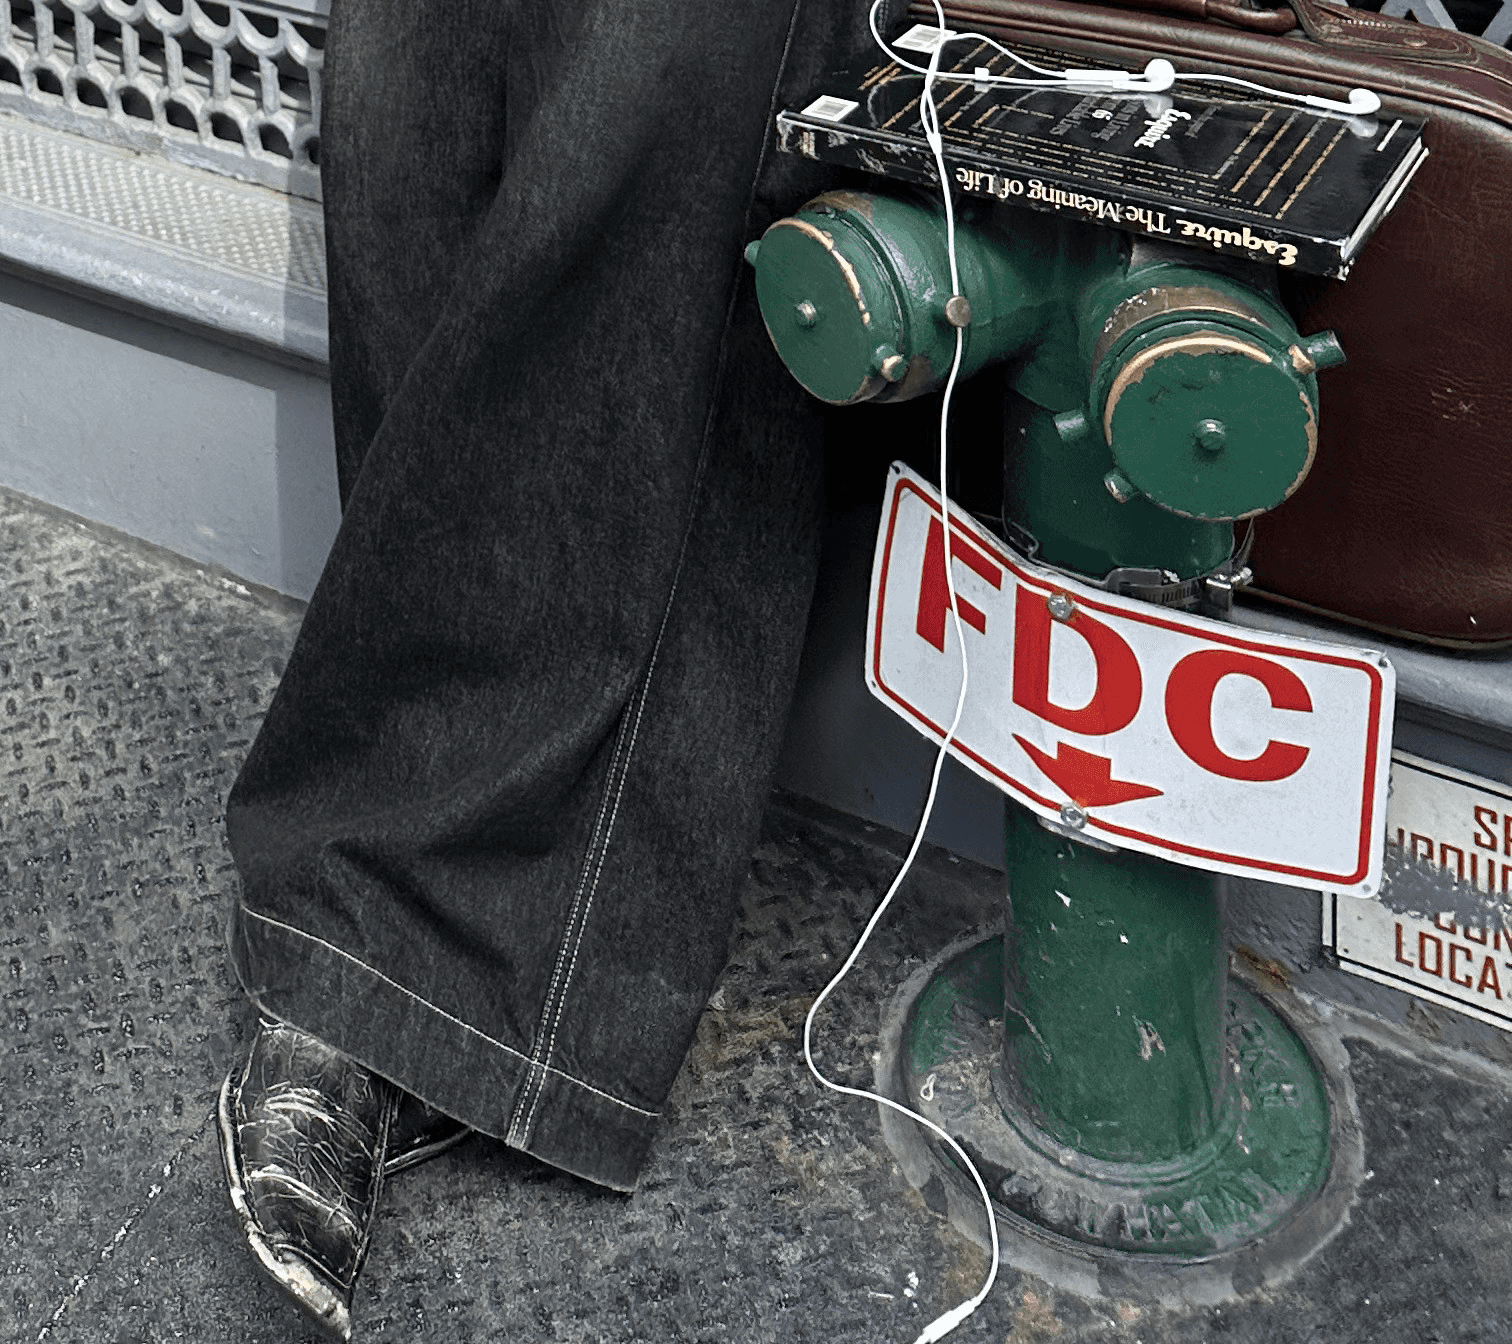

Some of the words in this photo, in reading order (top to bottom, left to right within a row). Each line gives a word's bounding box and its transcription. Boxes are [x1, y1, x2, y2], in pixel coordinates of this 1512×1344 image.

[955, 167, 997, 194] Life
[998, 178, 1025, 200] of
[1026, 178, 1122, 223] Meaning
[1124, 205, 1172, 234] The
[1176, 218, 1299, 267] Esquire
[916, 514, 1314, 782] FDC
